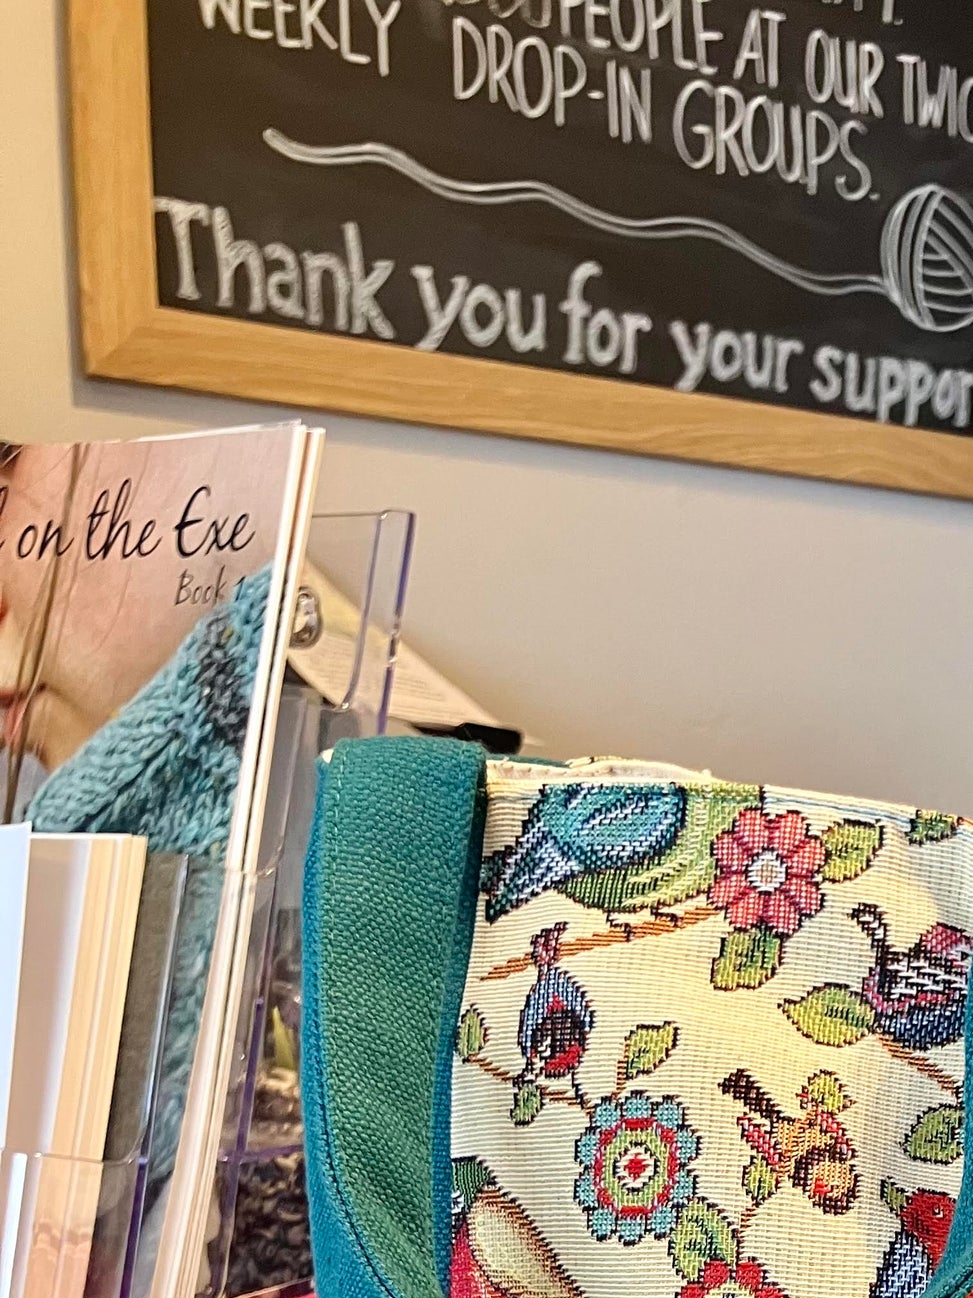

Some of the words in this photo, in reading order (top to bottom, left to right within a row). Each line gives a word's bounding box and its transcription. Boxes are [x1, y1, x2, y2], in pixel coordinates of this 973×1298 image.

[452, 16, 652, 144] DROP-IN
[673, 80, 880, 200] GROUPS.
[734, 8, 787, 88] AT
[804, 28, 884, 119] OUR
[153, 196, 396, 339] Thank
[410, 265, 547, 352] you
[558, 261, 652, 374] for
[669, 320, 804, 392] your
[16, 519, 75, 561] on
[86, 478, 163, 560] the
[173, 486, 257, 557] Exe
[175, 565, 229, 606] Book
